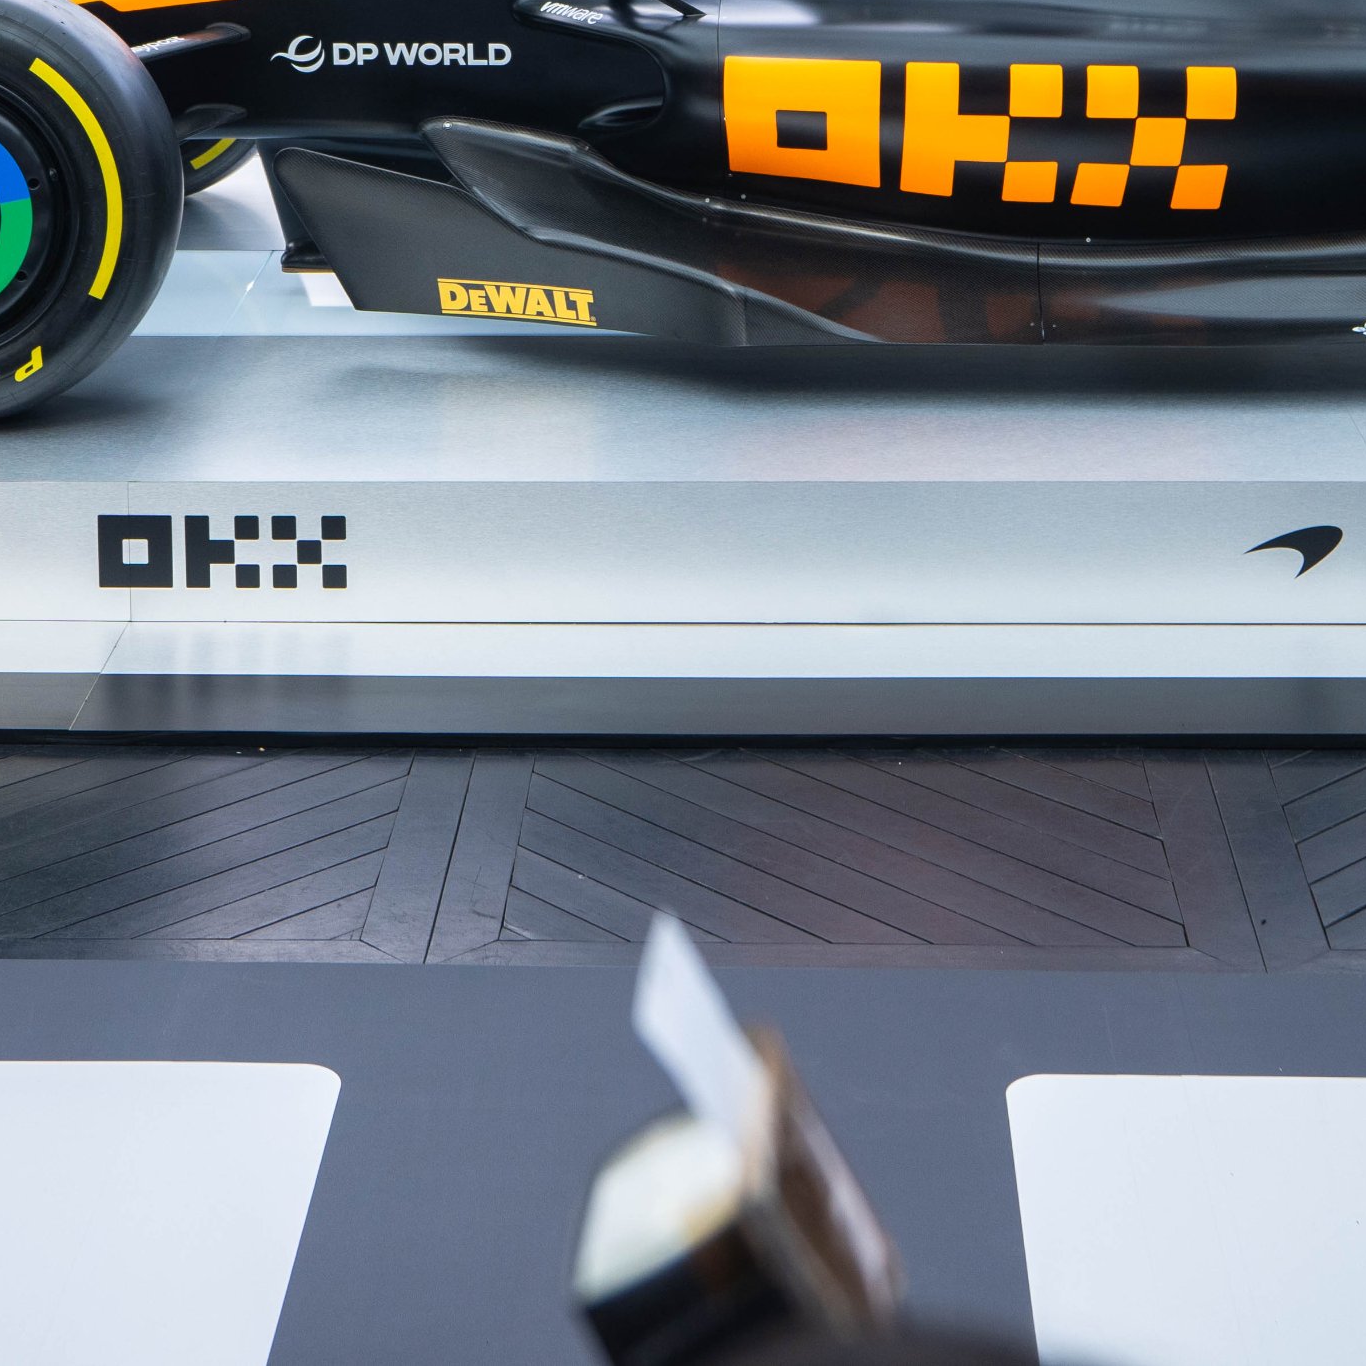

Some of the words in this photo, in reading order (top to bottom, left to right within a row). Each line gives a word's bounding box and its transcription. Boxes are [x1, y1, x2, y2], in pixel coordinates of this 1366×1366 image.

[540, 1, 604, 25] vmware
[332, 42, 379, 66] DP
[384, 42, 512, 66] WORLD
[724, 55, 1237, 210] OKX
[14, 346, 43, 383] P
[97, 514, 348, 589] OKX
